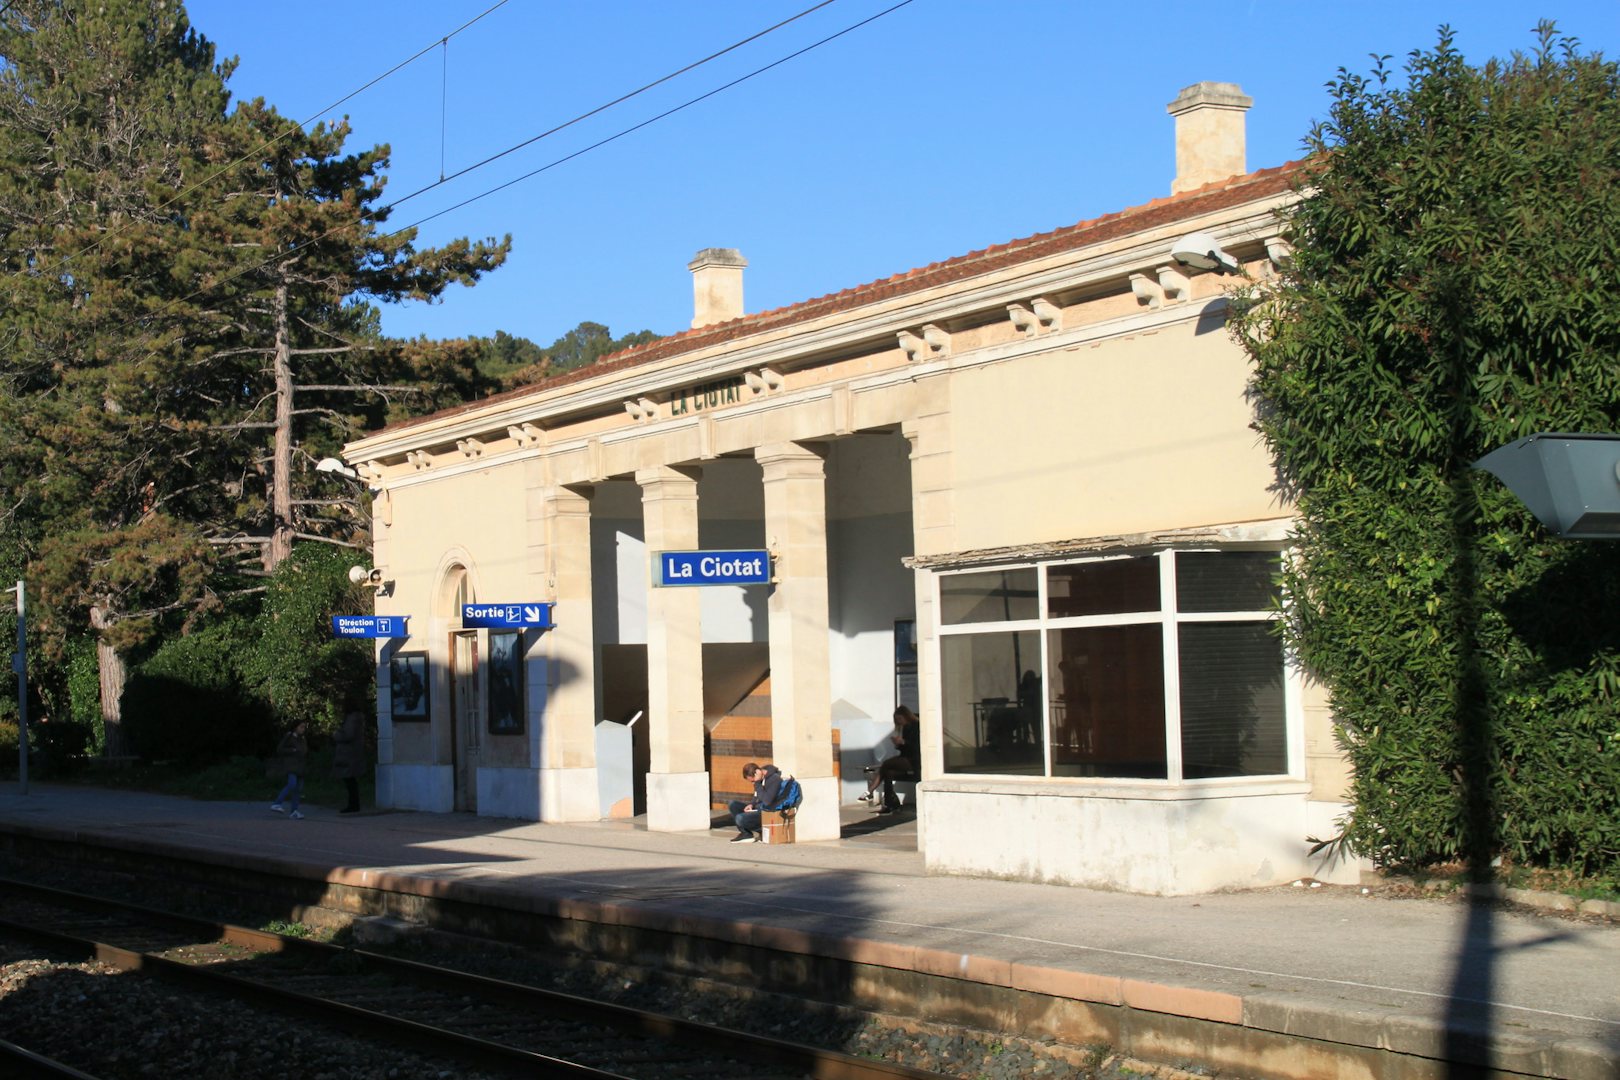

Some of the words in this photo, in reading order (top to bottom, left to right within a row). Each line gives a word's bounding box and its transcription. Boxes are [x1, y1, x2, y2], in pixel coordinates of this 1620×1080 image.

[671, 390, 689, 416] LA
[693, 375, 742, 411] CIOTAT
[668, 558, 693, 578] La
[700, 556, 762, 577] Ciotat
[465, 606, 505, 618] Sortie
[339, 618, 374, 626] Direction
[340, 626, 365, 634] Toulon
